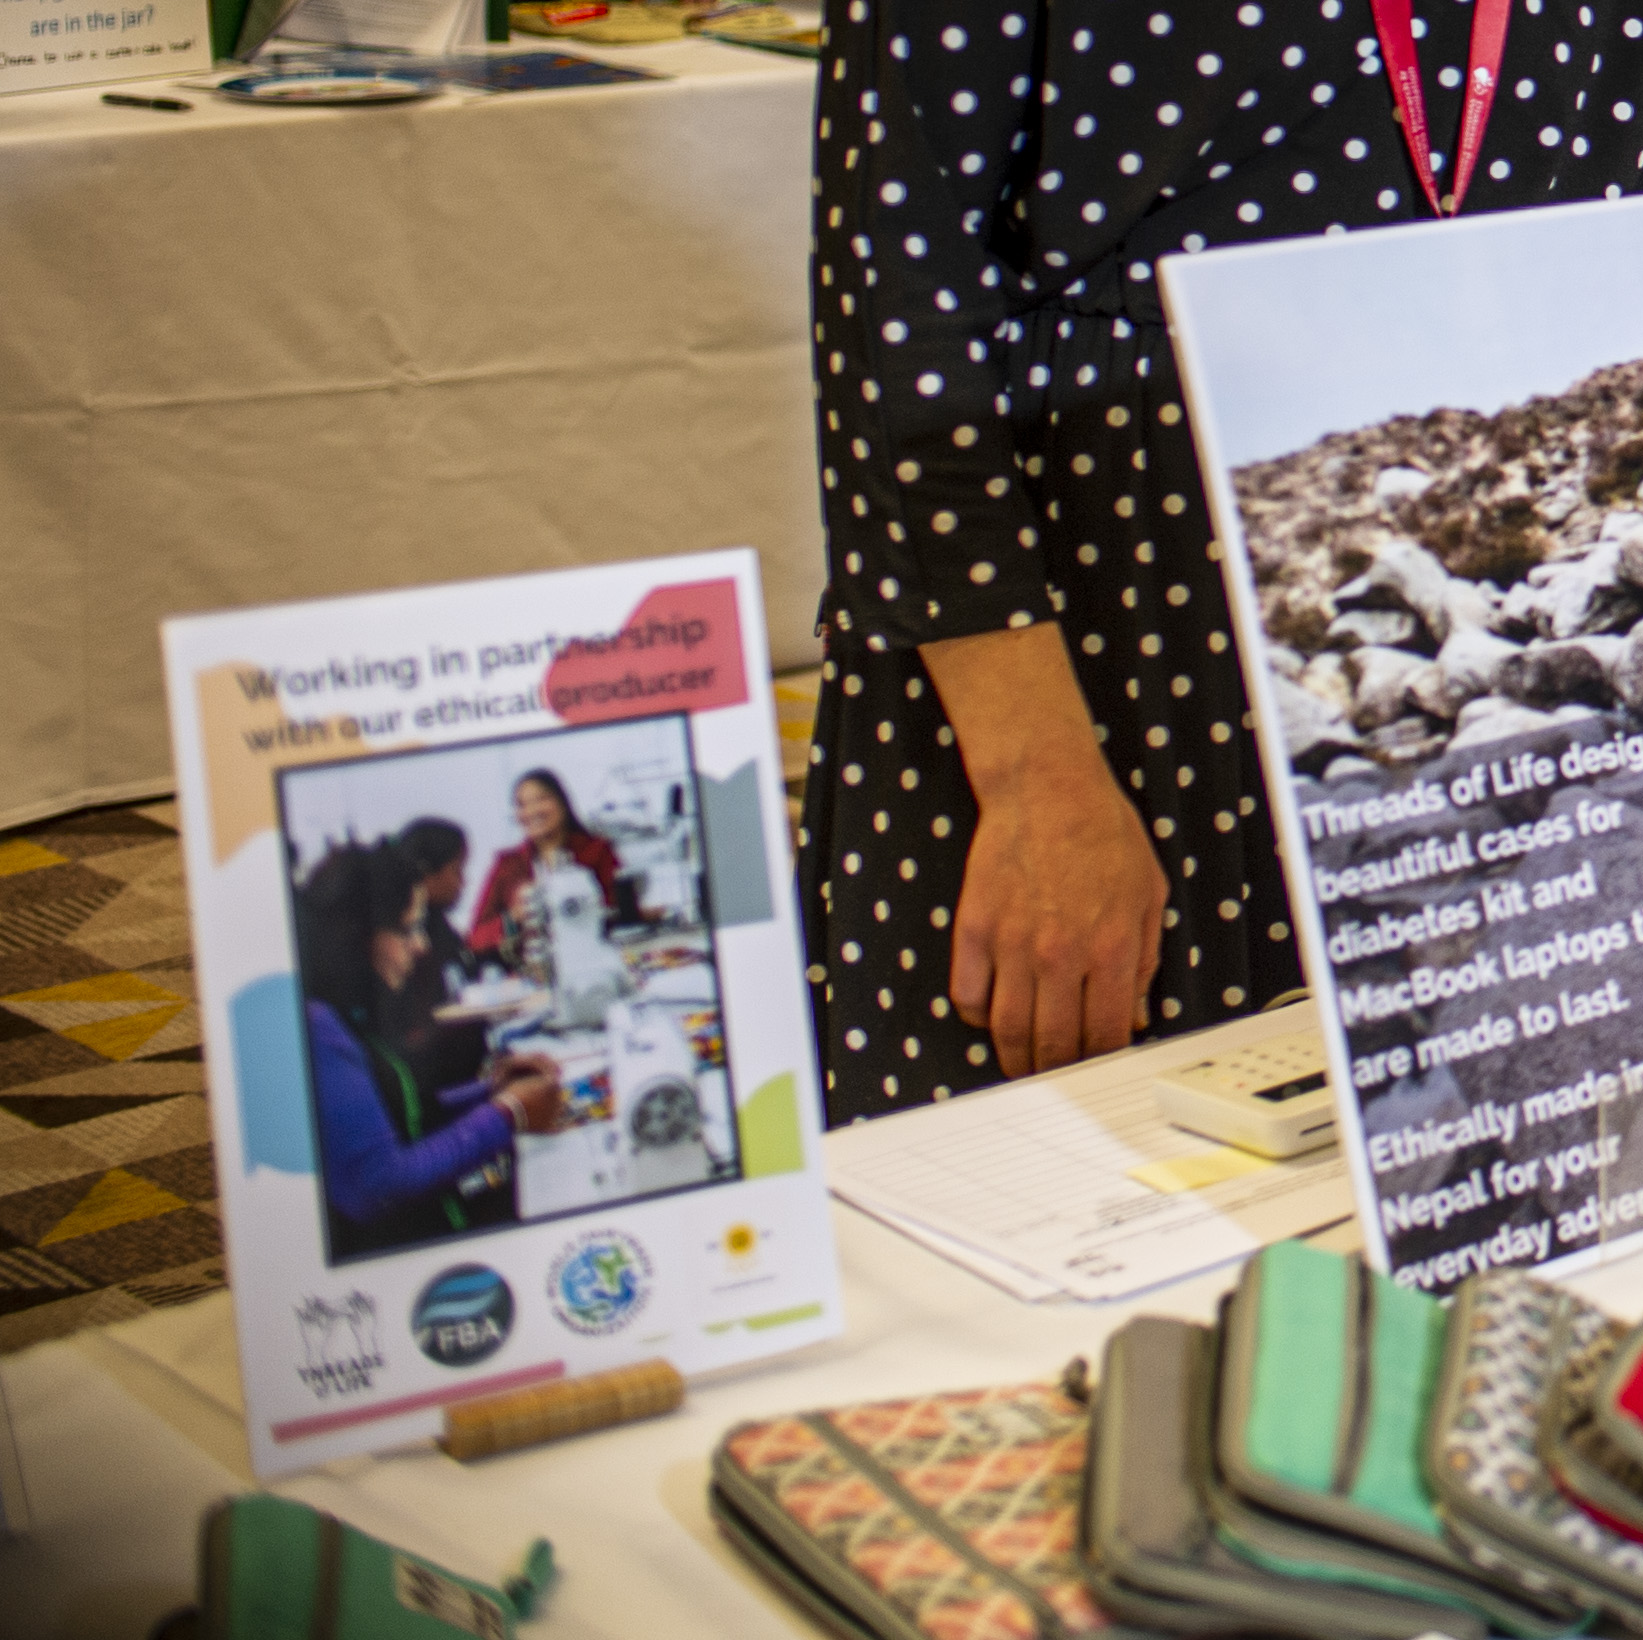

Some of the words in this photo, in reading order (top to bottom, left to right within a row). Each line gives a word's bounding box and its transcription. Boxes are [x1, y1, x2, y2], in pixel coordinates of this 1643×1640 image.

[30, 18, 59, 37] are
[65, 13, 80, 34] in
[86, 10, 116, 31] the
[121, 4, 154, 33] jar?
[234, 653, 417, 702] Working
[431, 644, 470, 678] in
[480, 616, 708, 677] partnership
[242, 711, 329, 751] with
[341, 707, 402, 741] our
[414, 687, 542, 730] ethical
[556, 664, 715, 712] producer
[1302, 780, 1445, 840] Threads
[1450, 768, 1488, 806] of
[1492, 746, 1555, 797] Life
[1316, 830, 1475, 903] beautiful
[1479, 816, 1572, 861] cases
[1577, 796, 1625, 837] for
[1329, 893, 1478, 963] diabetes
[1483, 883, 1527, 922] kit
[1531, 862, 1596, 908] and
[1340, 950, 1499, 1026] MacBook
[1504, 922, 1628, 976] laptops
[1351, 1051, 1413, 1088] are
[1418, 1015, 1515, 1069] made
[1519, 1002, 1557, 1035] to
[1560, 978, 1630, 1025] last.
[1367, 1100, 1519, 1172] Ethically
[1524, 1066, 1616, 1124] made
[1379, 1170, 1490, 1235] Nepal
[1491, 1159, 1542, 1199] for
[1545, 1135, 1622, 1191] your
[1394, 1220, 1551, 1288] everyday
[437, 1316, 501, 1353] FBA
